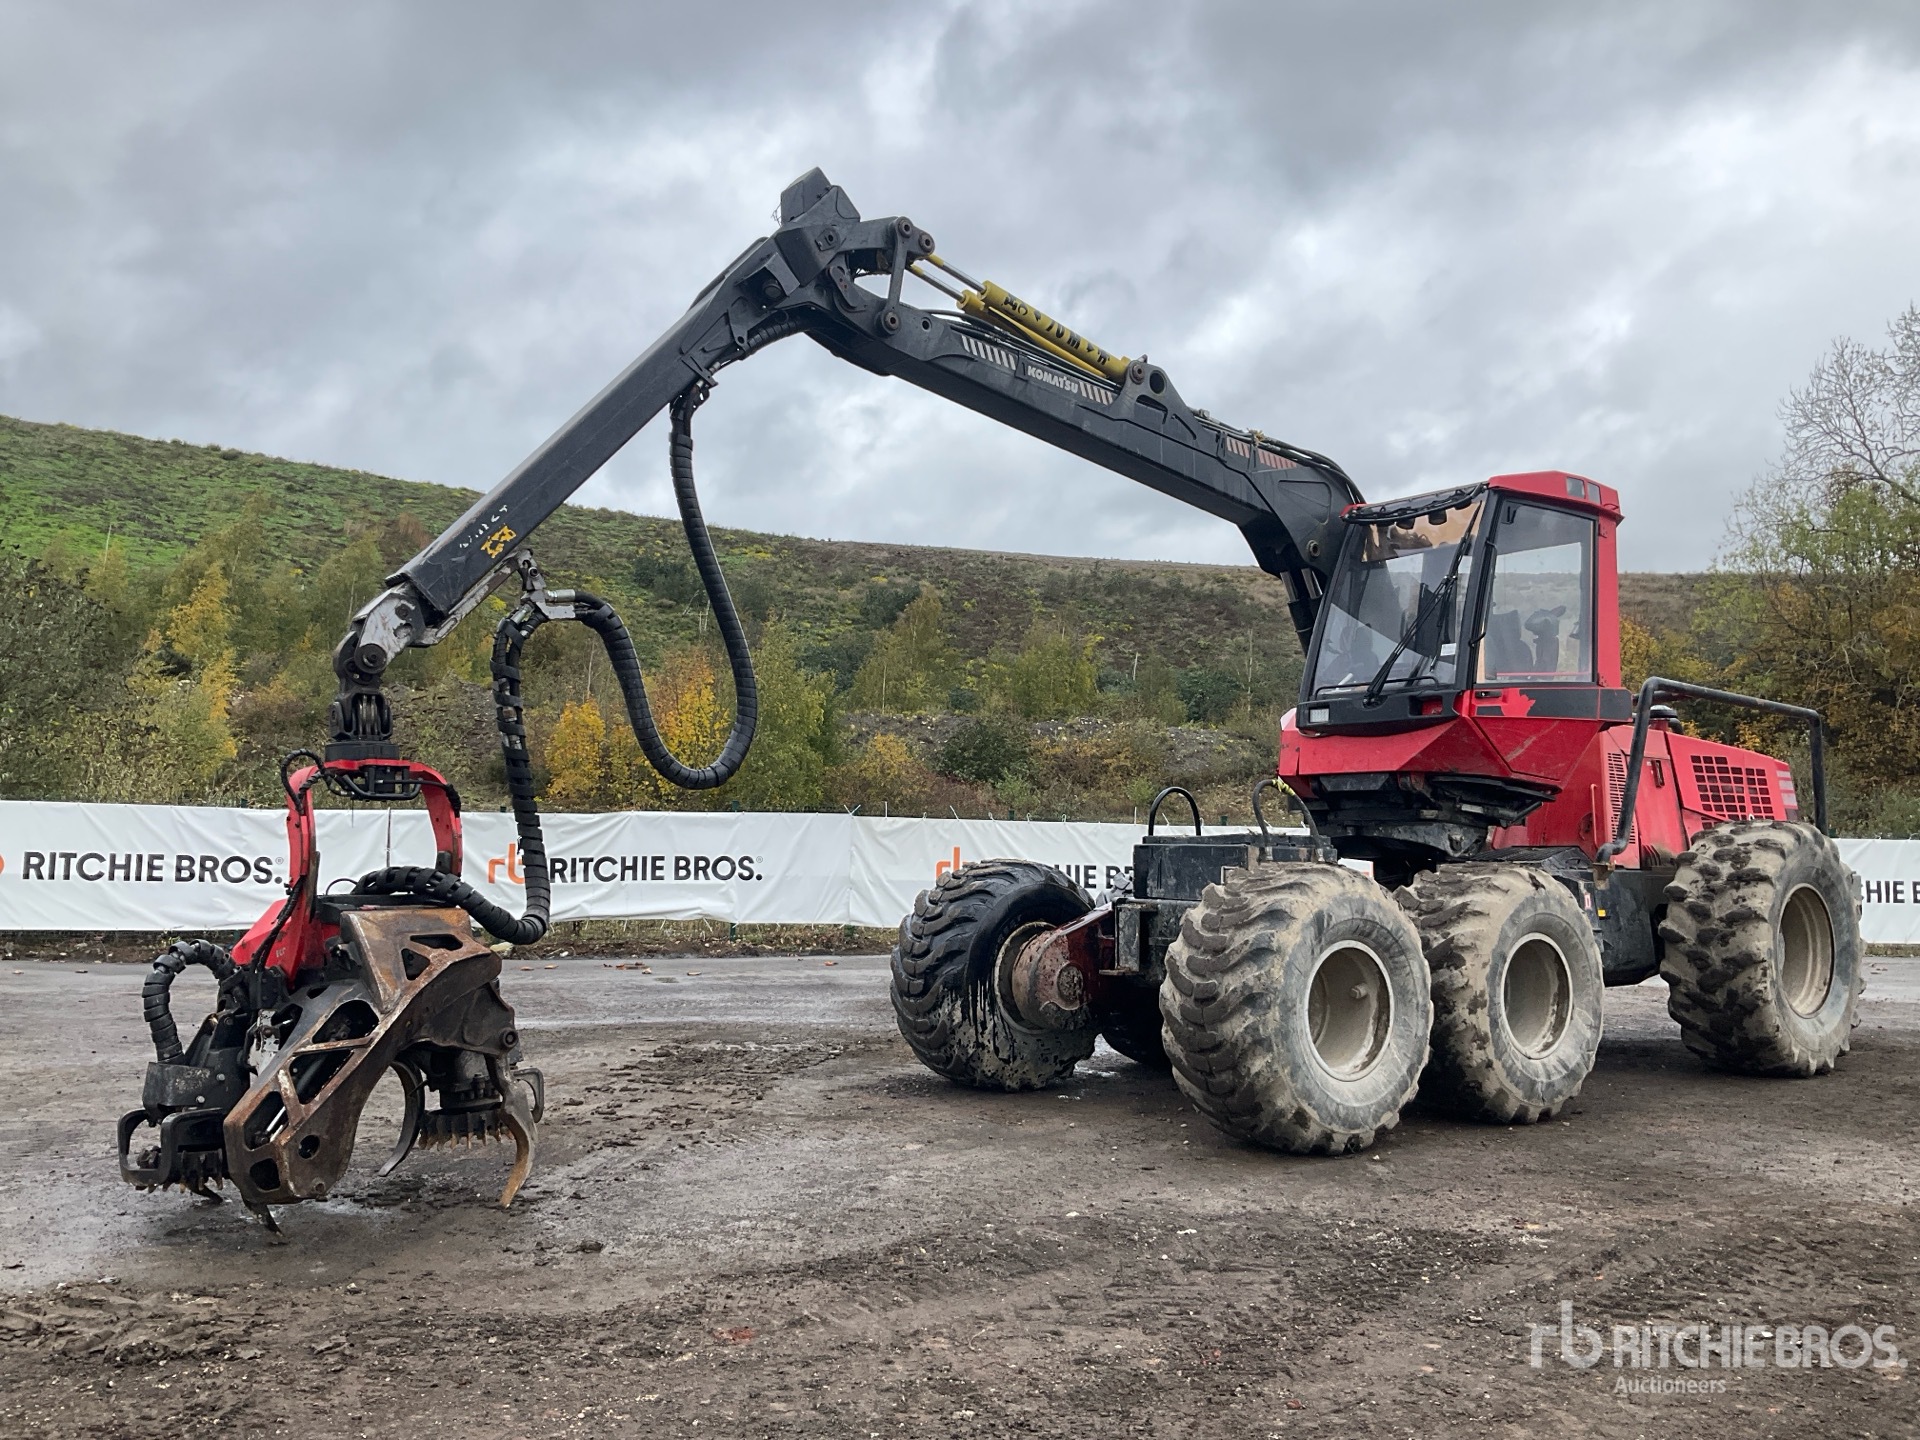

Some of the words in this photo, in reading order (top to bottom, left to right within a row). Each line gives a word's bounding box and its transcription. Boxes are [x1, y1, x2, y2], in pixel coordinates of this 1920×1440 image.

[1027, 365, 1078, 394] KOMATSU
[22, 851, 164, 882] RITCHIE
[549, 856, 665, 884] RITCHIE
